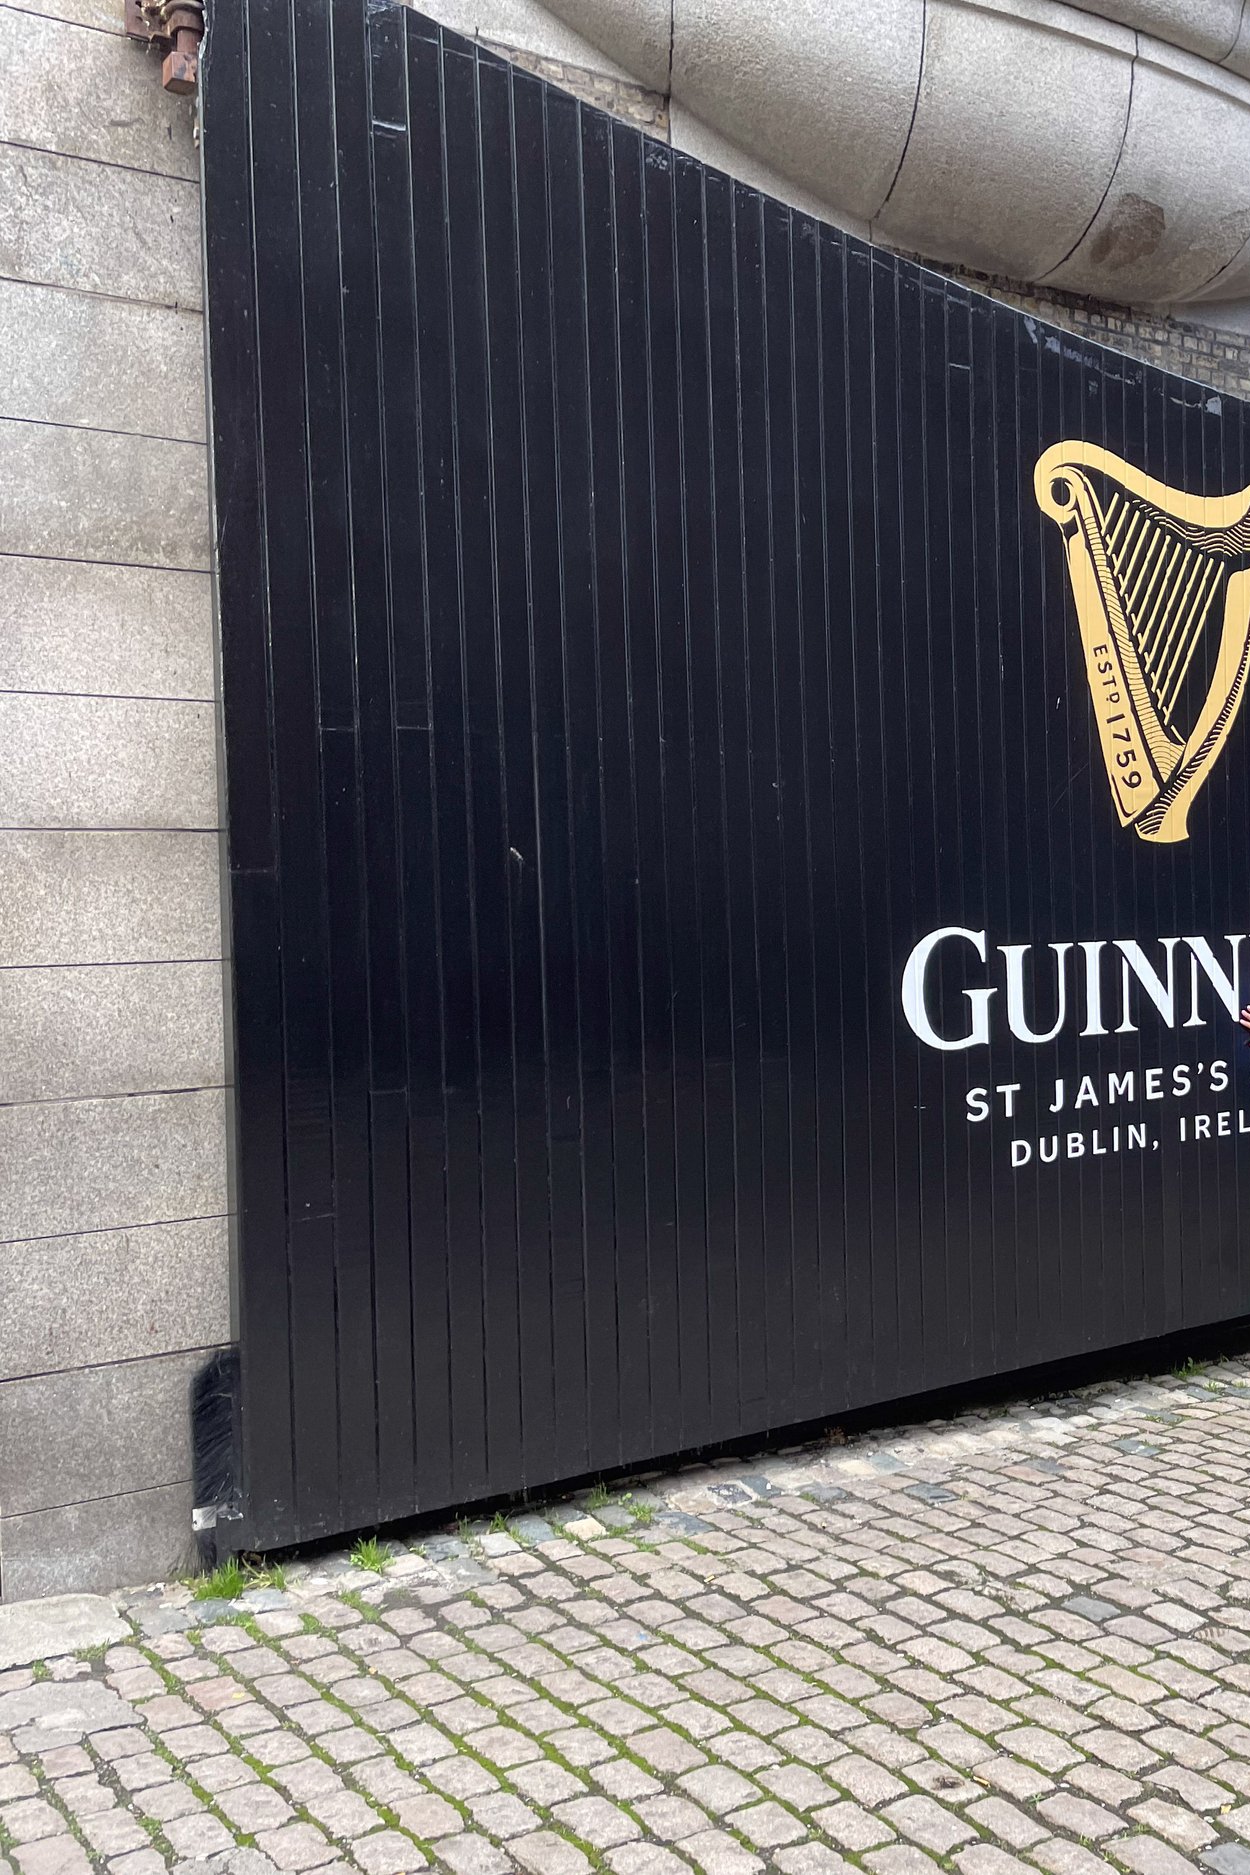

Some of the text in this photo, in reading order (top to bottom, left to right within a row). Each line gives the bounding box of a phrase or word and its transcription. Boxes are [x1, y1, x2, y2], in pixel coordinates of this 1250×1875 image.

[1106, 713, 1142, 789] 1759
[966, 1084, 1020, 1121] ST
[1012, 1123, 1158, 1167] DUBLIN,
